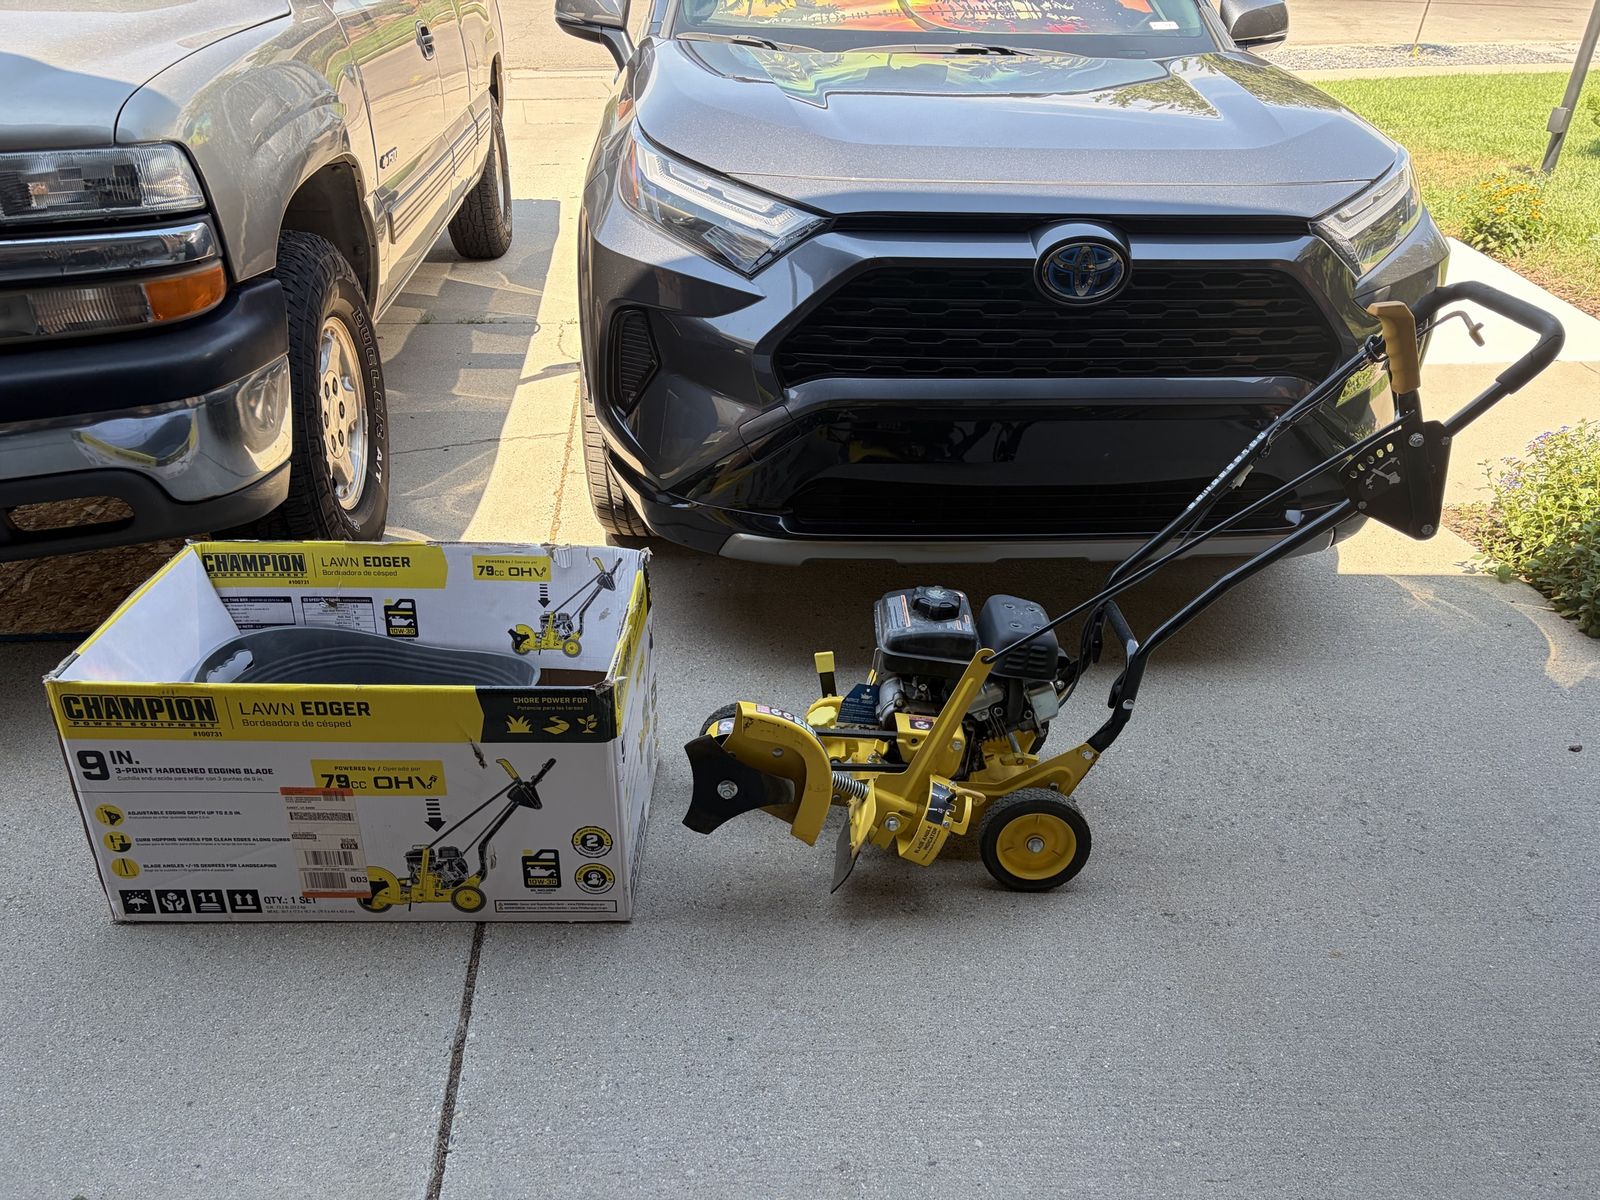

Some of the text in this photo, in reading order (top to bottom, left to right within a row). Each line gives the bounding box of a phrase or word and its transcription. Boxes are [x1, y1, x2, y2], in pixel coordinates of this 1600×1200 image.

[352, 306, 385, 484] DUELER A/T
[202, 553, 305, 572] CHAMPION
[321, 556, 411, 567] LAWN EDGER
[373, 569, 398, 577] césped
[476, 565, 546, 577] 79cc OHV
[62, 696, 217, 721] CHAMPION
[239, 701, 371, 716] LAWN EDGER
[242, 719, 352, 729] Bordeadora de césped
[76, 750, 140, 781] 9 IN.
[320, 773, 438, 790] 79cc OHV
[586, 834, 599, 847] 2
[263, 896, 288, 904] QTY.:
[290, 896, 296, 904] 1
